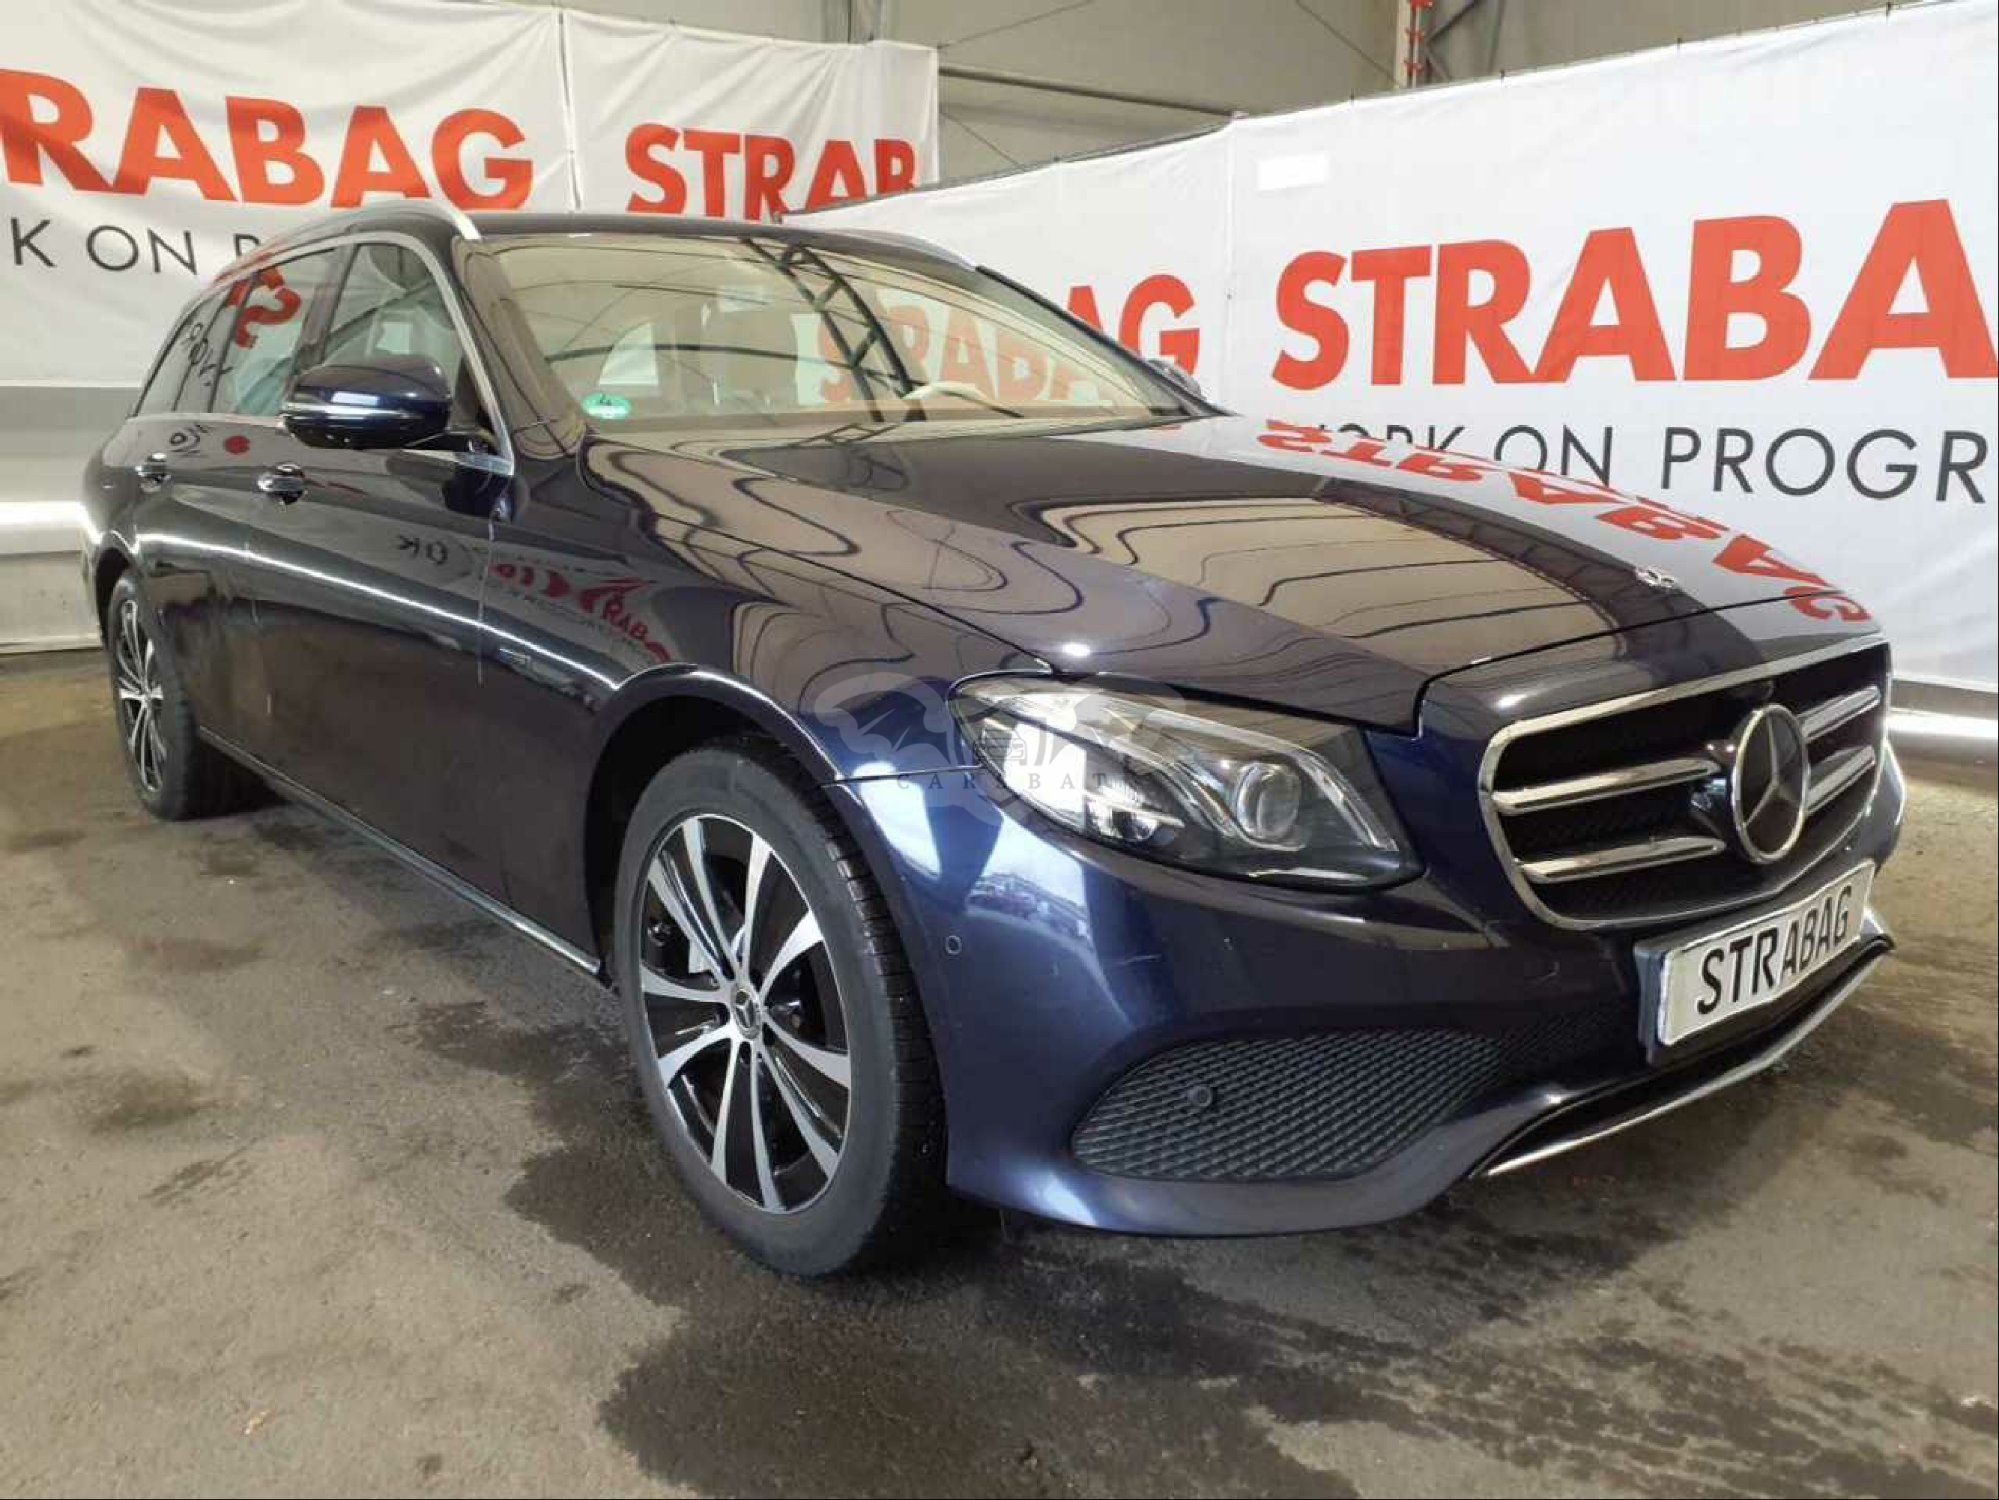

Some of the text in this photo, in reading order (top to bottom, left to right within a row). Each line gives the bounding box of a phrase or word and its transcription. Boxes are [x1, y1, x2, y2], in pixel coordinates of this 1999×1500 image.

[0, 68, 533, 211] RABAG
[86, 225, 198, 275] ON
[1271, 199, 1998, 390] STRABA
[1494, 425, 1988, 504] ON PROGR
[1697, 885, 1852, 1015] STRABAG
